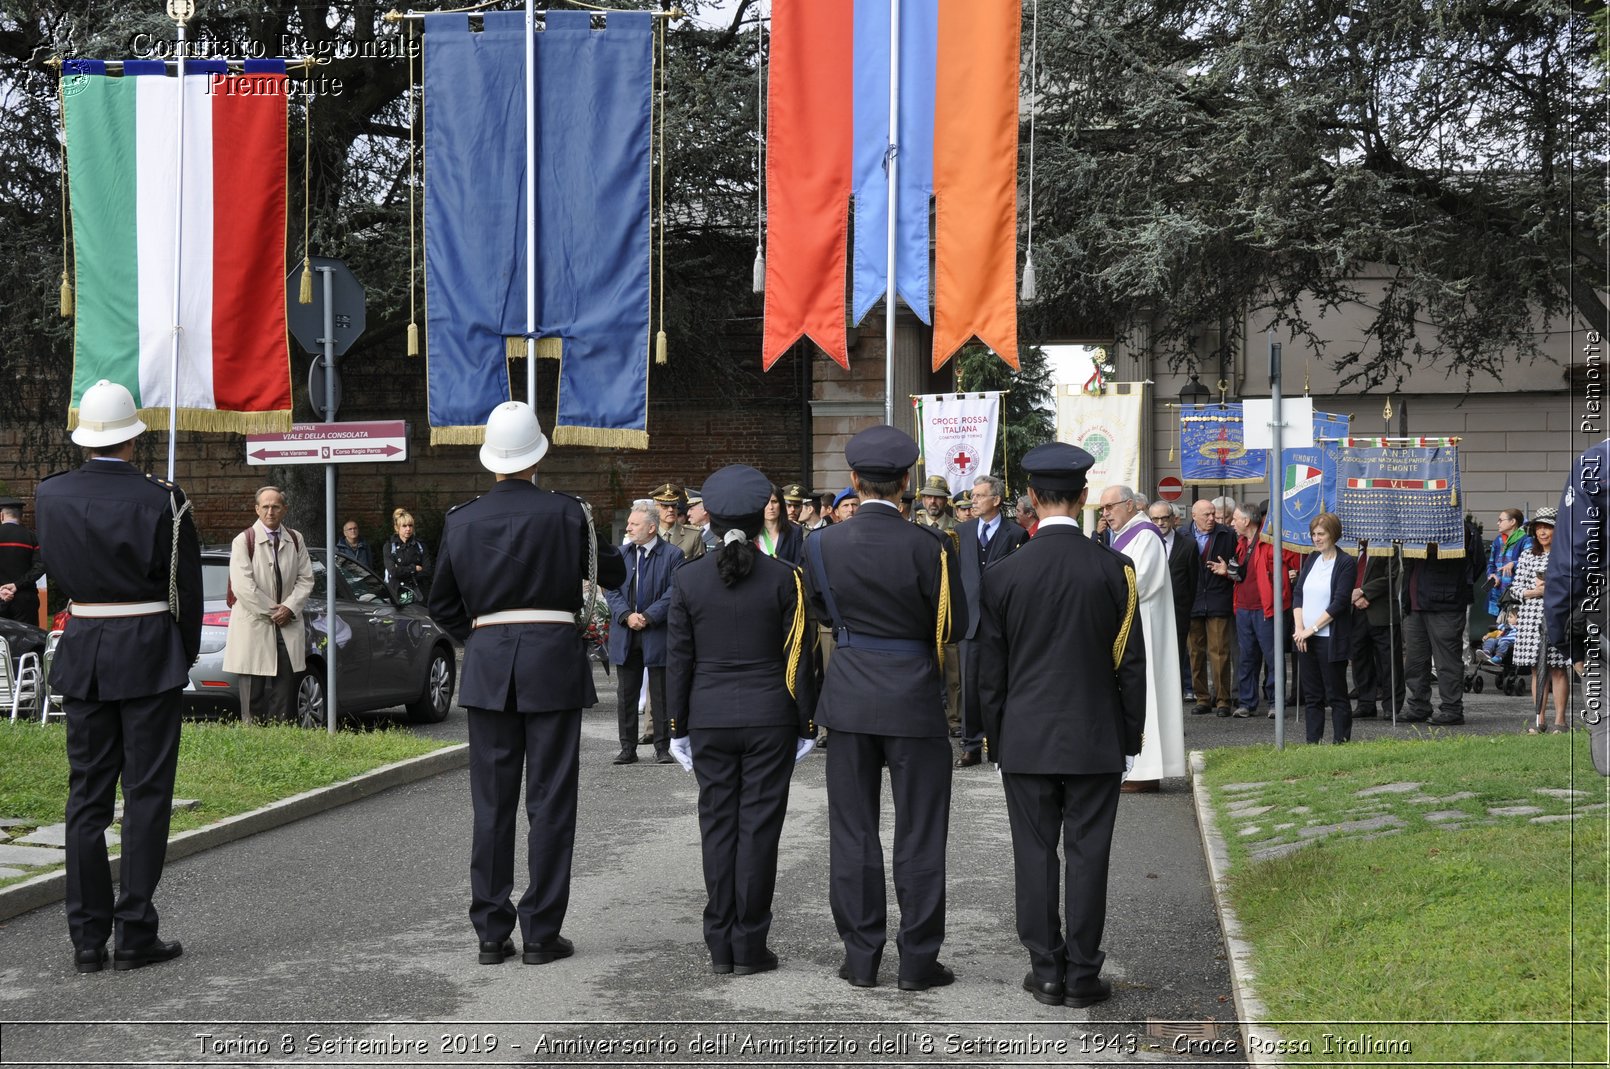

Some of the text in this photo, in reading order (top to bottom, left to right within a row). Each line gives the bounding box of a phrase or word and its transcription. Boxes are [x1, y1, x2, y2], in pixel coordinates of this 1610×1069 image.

[932, 416, 989, 426] CROCE ROSSA
[943, 425, 978, 434] ITALIANA
[304, 432, 327, 440] DELLA
[327, 431, 369, 439] CONSOLATA
[1293, 453, 1318, 464] PIEMONTE
